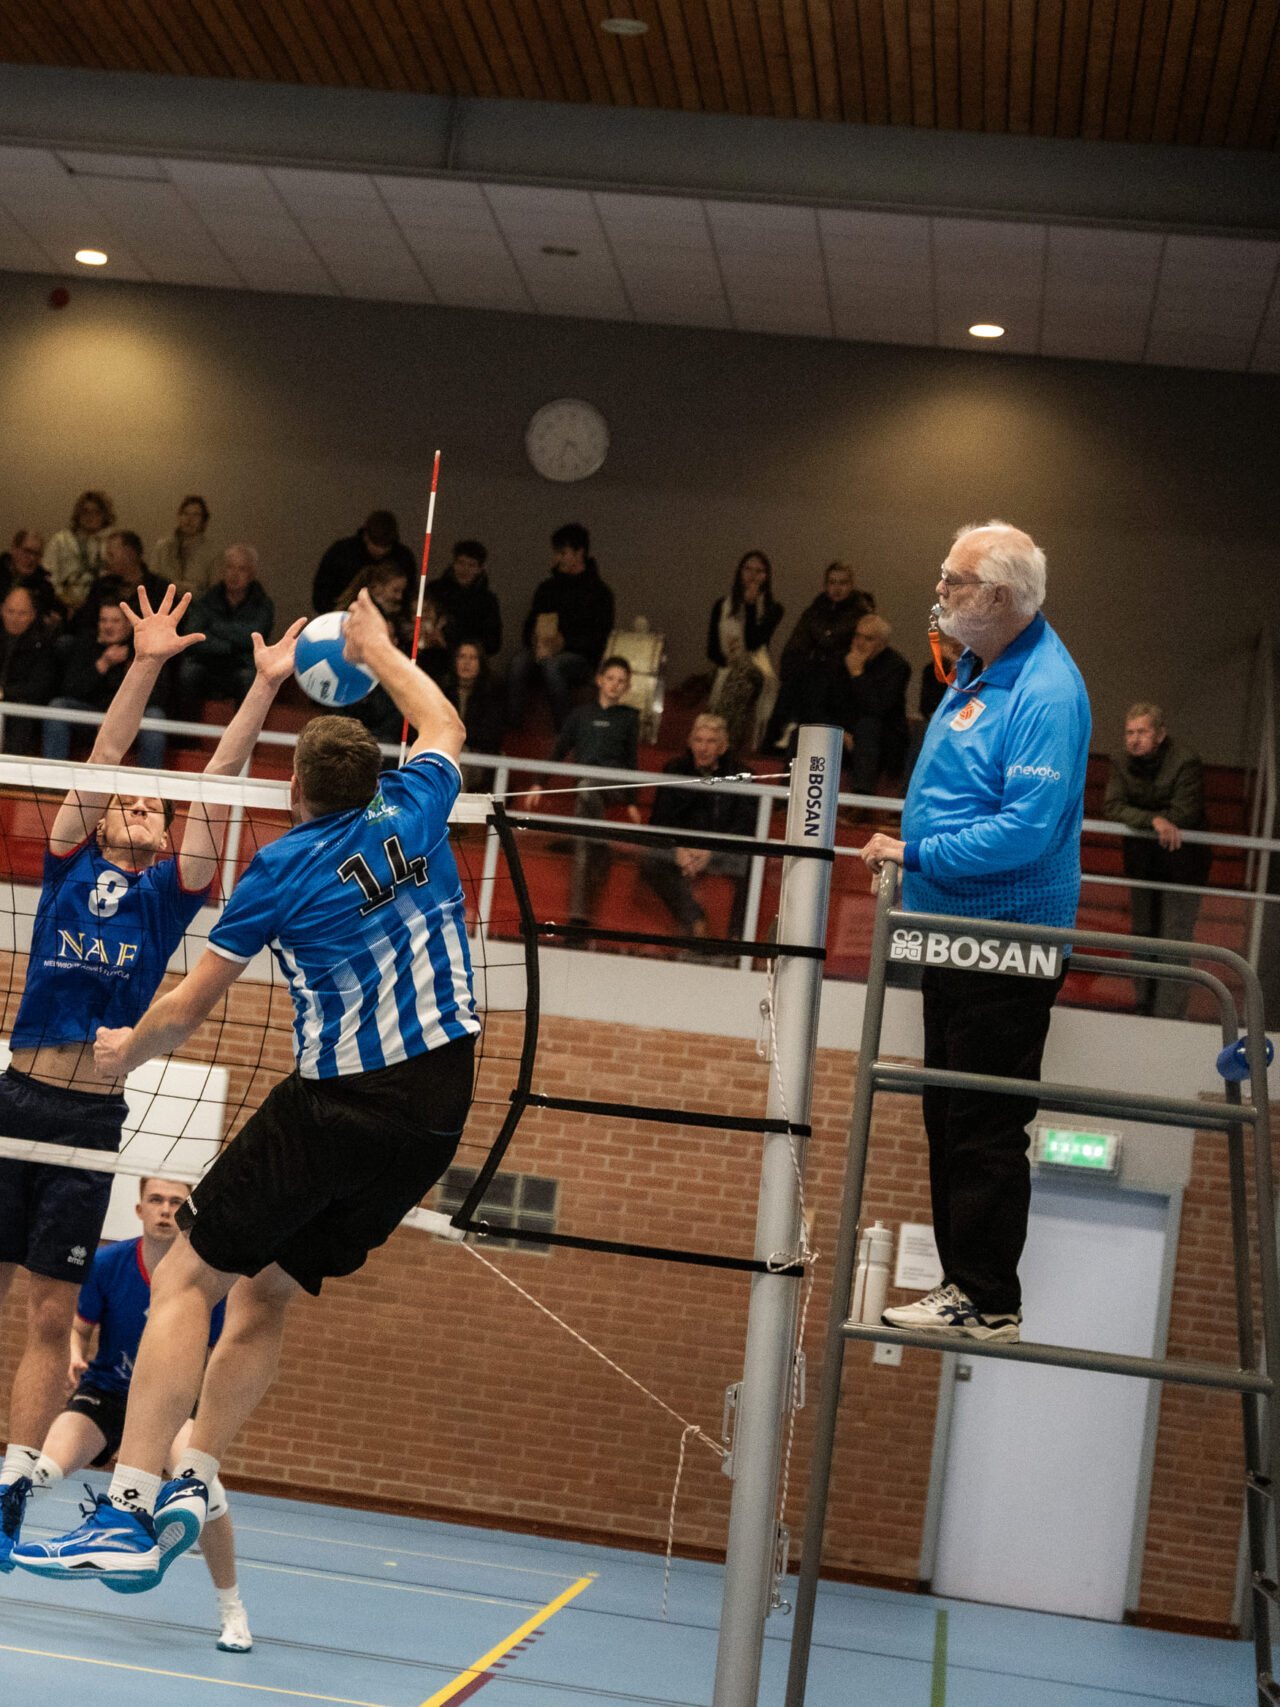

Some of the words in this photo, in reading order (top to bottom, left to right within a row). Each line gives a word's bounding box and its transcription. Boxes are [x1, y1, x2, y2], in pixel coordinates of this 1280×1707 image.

[1013, 765, 1061, 780] nevobo
[803, 773, 824, 837] BOSAN
[88, 870, 129, 918] 8
[336, 834, 429, 917] 14
[57, 929, 138, 968] NAF
[925, 932, 1058, 977] BOSAN
